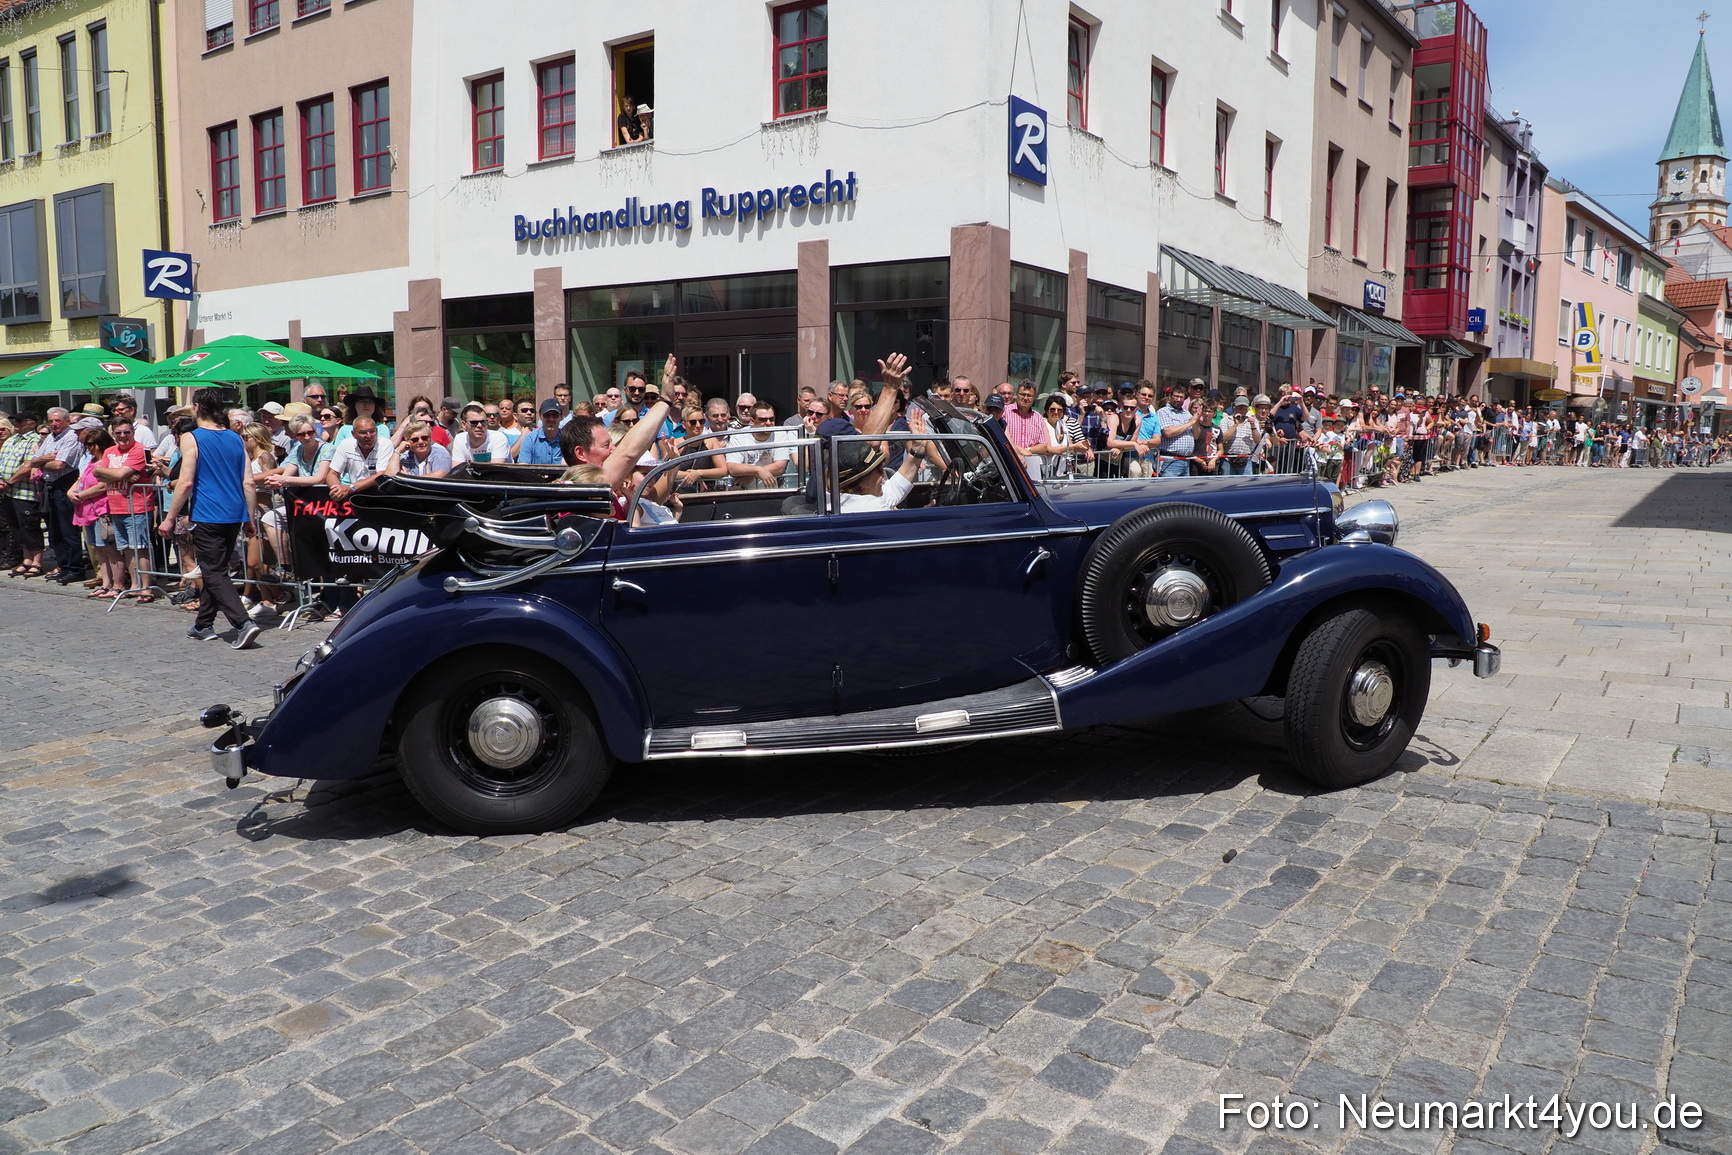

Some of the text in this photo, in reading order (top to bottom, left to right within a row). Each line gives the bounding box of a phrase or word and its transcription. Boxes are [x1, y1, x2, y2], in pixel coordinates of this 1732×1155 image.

[514, 168, 857, 242] Buchhandlung Rupprecht
[213, 312, 227, 321] Markt
[226, 311, 232, 320] 15
[120, 328, 137, 348] G2
[1577, 333, 1591, 346] B
[293, 499, 355, 517] FAHRS
[328, 551, 373, 565] Neumarkt
